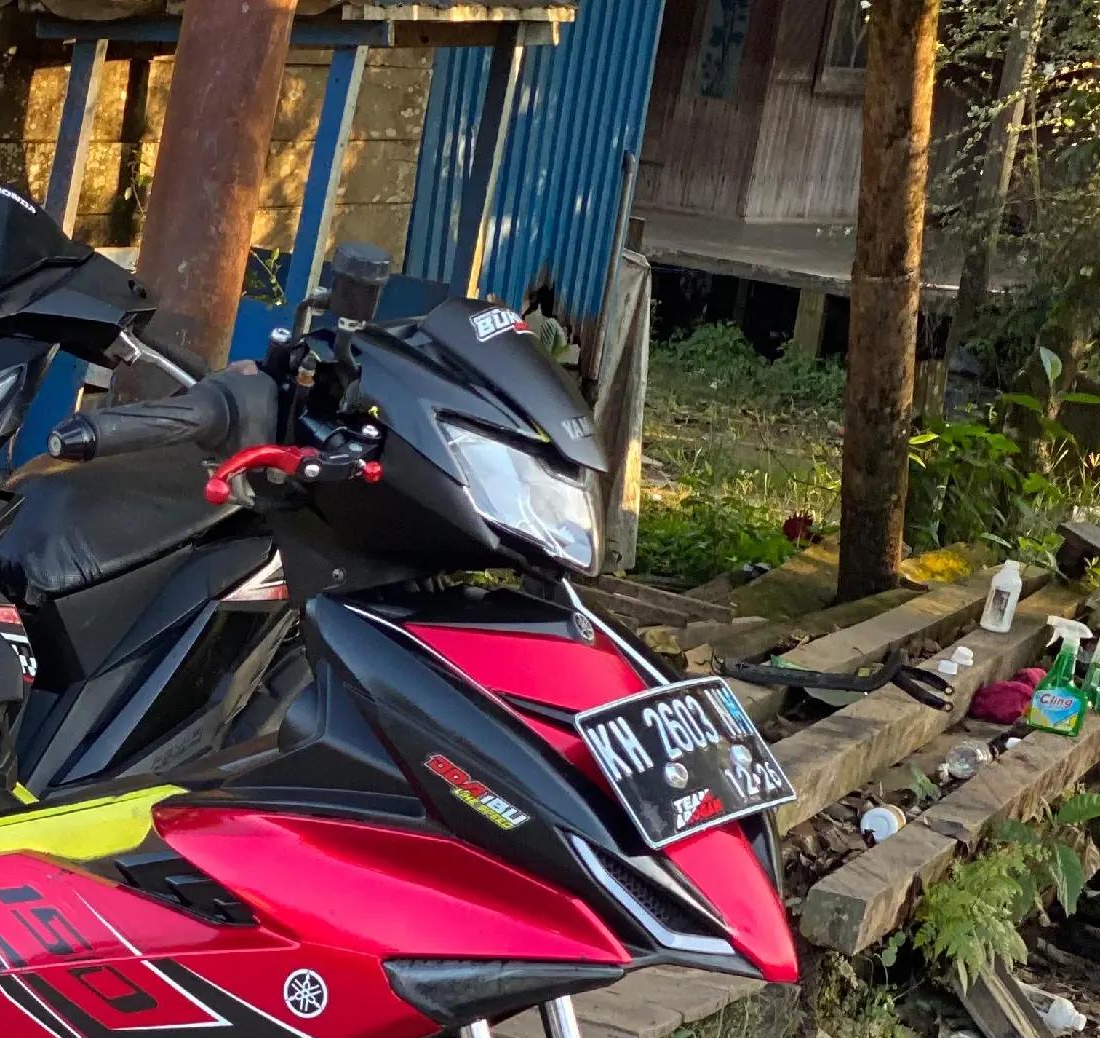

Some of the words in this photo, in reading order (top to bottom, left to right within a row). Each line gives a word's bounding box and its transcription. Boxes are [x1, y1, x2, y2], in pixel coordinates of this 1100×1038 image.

[1039, 692, 1073, 708] Cling
[587, 716, 654, 781] KH
[642, 695, 720, 759] 2603
